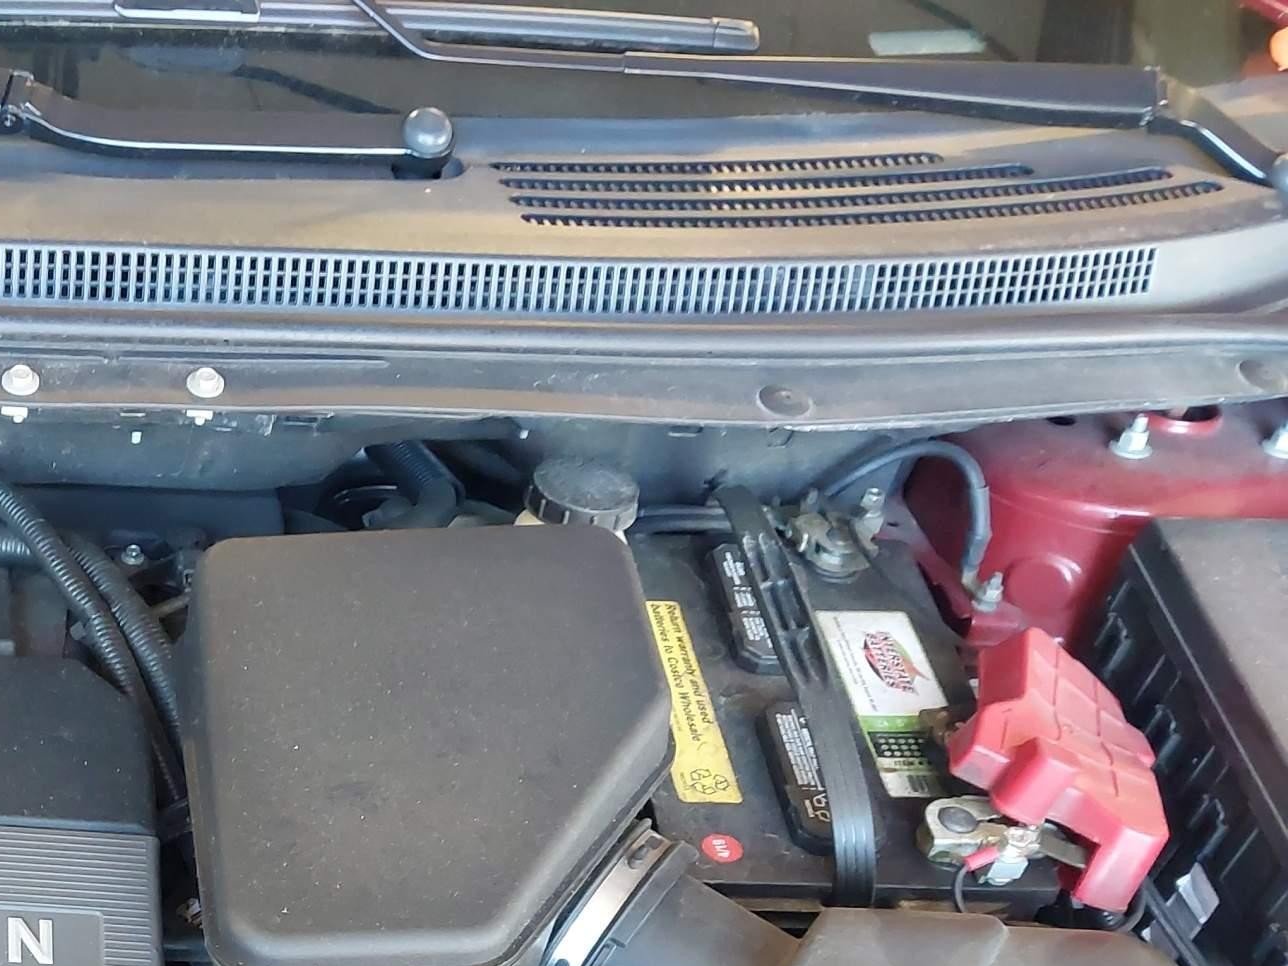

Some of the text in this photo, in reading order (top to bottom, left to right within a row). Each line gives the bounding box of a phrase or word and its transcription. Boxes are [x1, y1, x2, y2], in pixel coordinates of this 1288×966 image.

[667, 656, 684, 688] Costco
[678, 691, 701, 741] Wholesale
[676, 636, 695, 675] warranty
[690, 679, 703, 701] and
[697, 700, 713, 724] used
